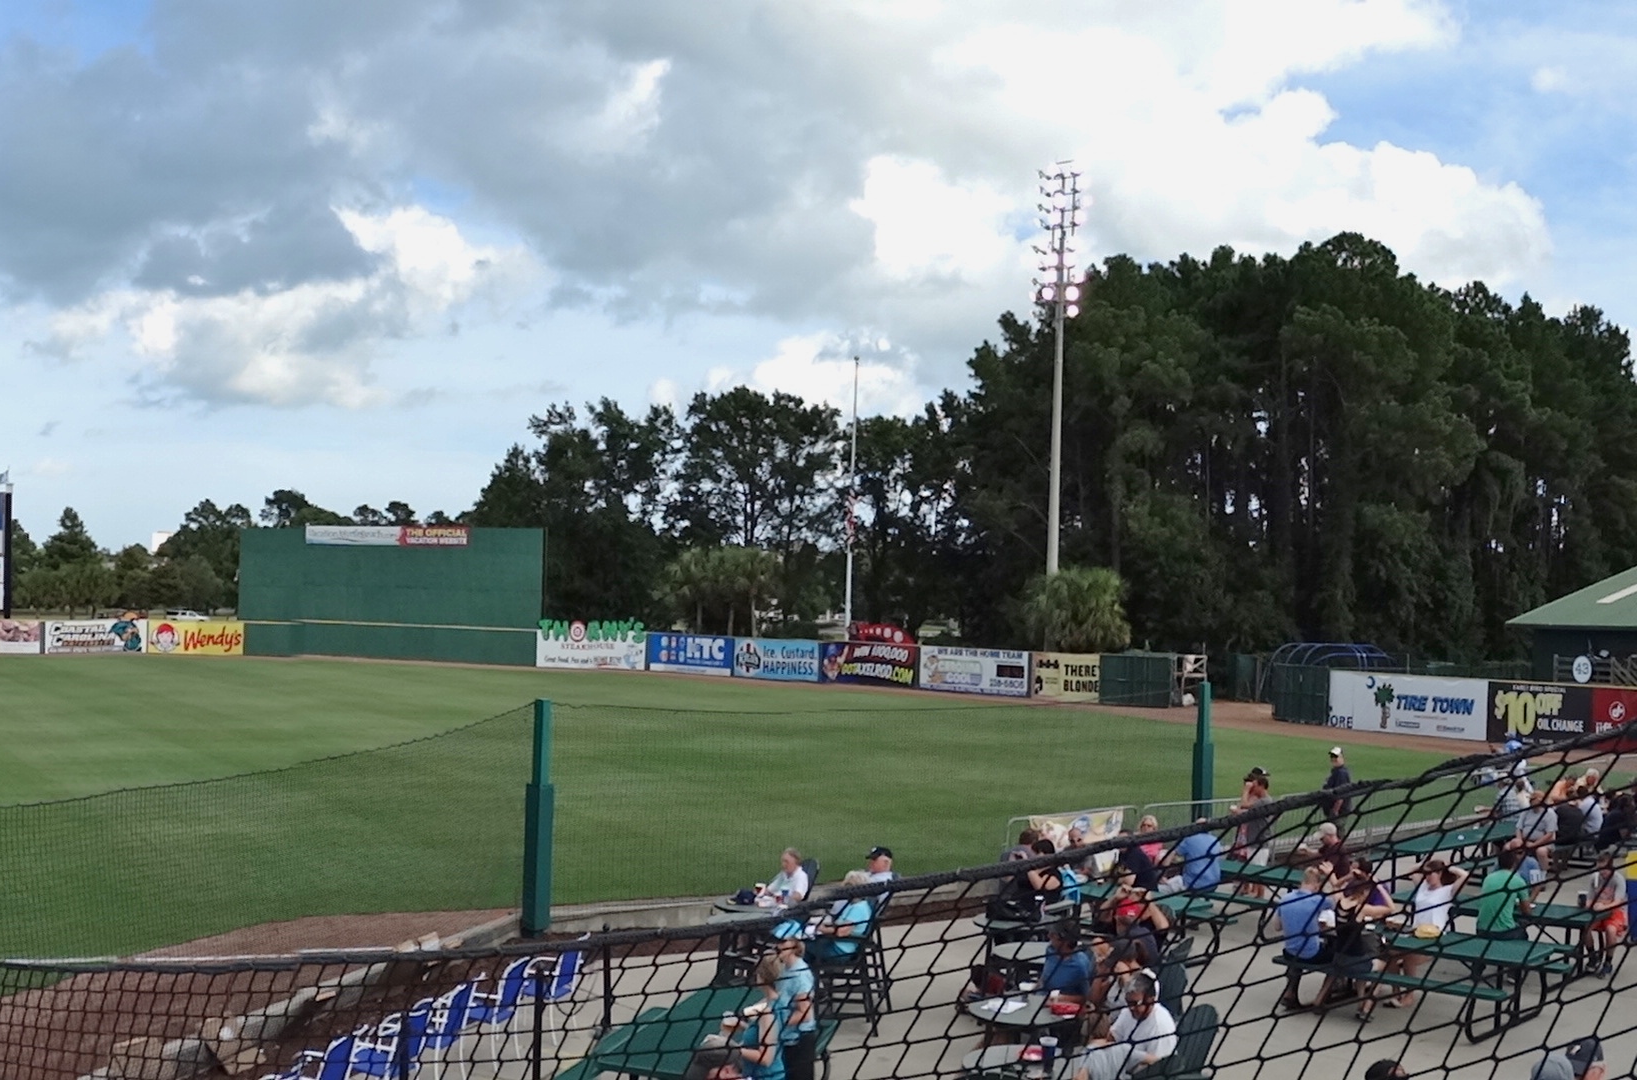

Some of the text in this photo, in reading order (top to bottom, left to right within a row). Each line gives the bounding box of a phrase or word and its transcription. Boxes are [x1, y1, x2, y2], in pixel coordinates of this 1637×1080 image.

[406, 528, 467, 538] THE OFFICIAL
[406, 537, 438, 545] VACATION
[49, 622, 107, 636] COASTAL
[538, 616, 646, 644] THORNY'S
[52, 633, 117, 647] CAROLINA
[183, 625, 243, 653] Wendy's
[560, 643, 616, 651] STEAKHOUSE
[687, 637, 725, 661] HTC
[950, 648, 964, 656] ARE
[965, 649, 978, 657] THE
[979, 650, 1001, 659] HOME
[1002, 651, 1024, 660] TEAM
[1575, 663, 1590, 676] 43
[1063, 679, 1100, 693] BLONDE
[1396, 694, 1475, 716] TIRE TOWN
[1536, 693, 1563, 715] OFF
[1494, 690, 1536, 736] $10
[1537, 718, 1551, 731] OIL
[1551, 719, 1585, 733] CHANGE
